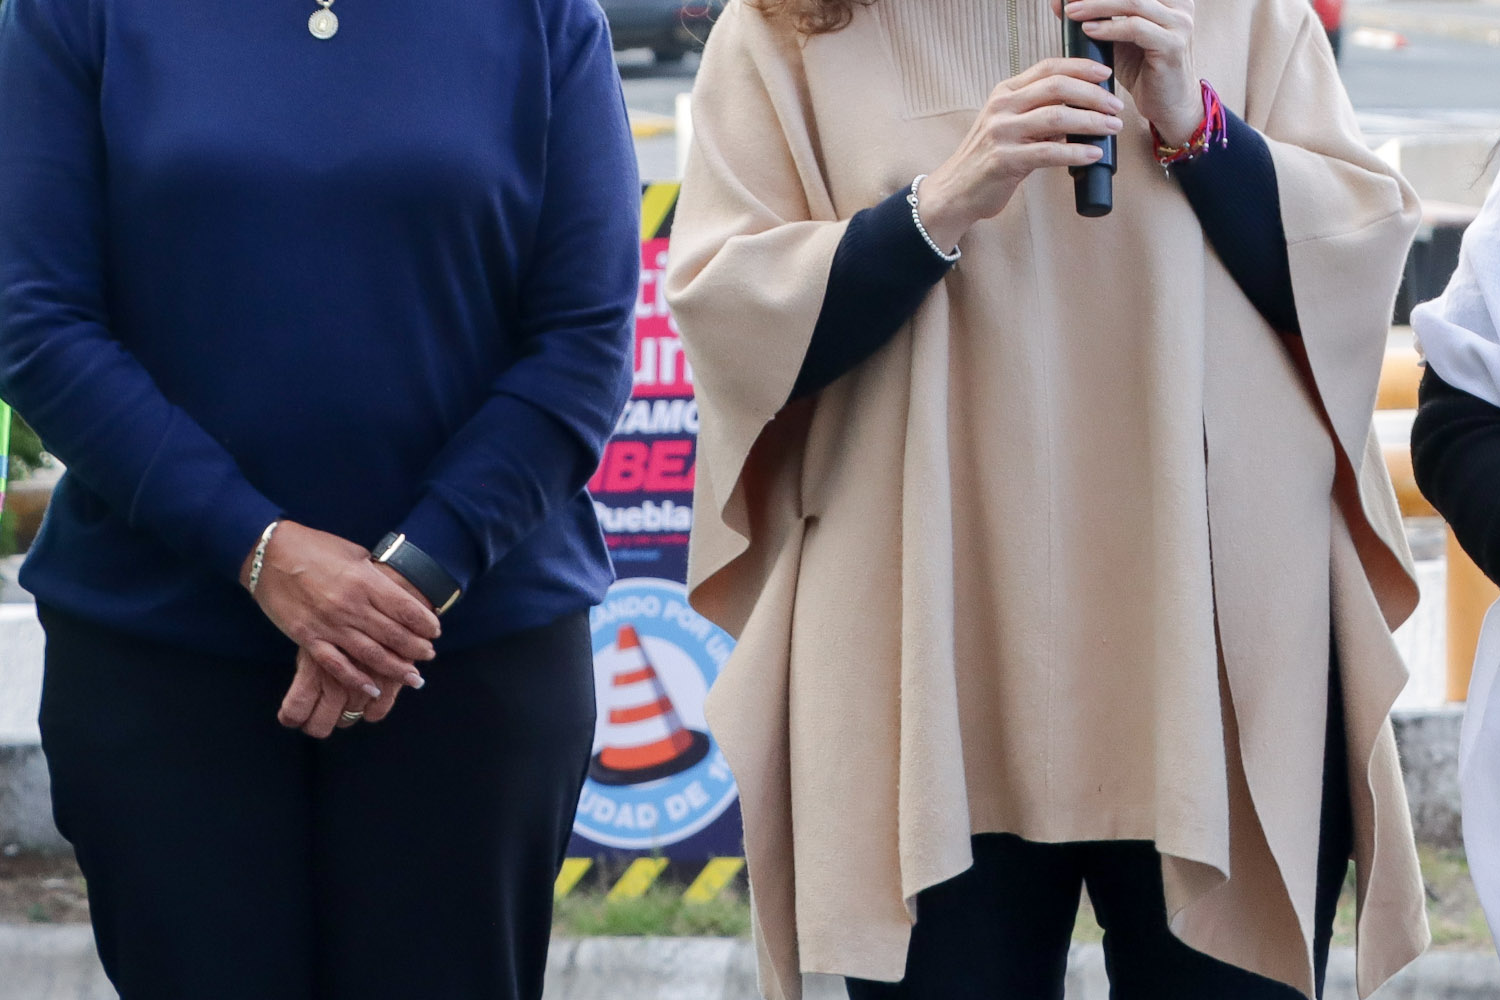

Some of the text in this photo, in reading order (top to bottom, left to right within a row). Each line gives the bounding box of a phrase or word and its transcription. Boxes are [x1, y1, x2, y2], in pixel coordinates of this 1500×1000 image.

[587, 440, 696, 492] BE
[590, 595, 661, 634] ANDO
[577, 786, 659, 829] UDAD
[664, 780, 711, 822] DE
